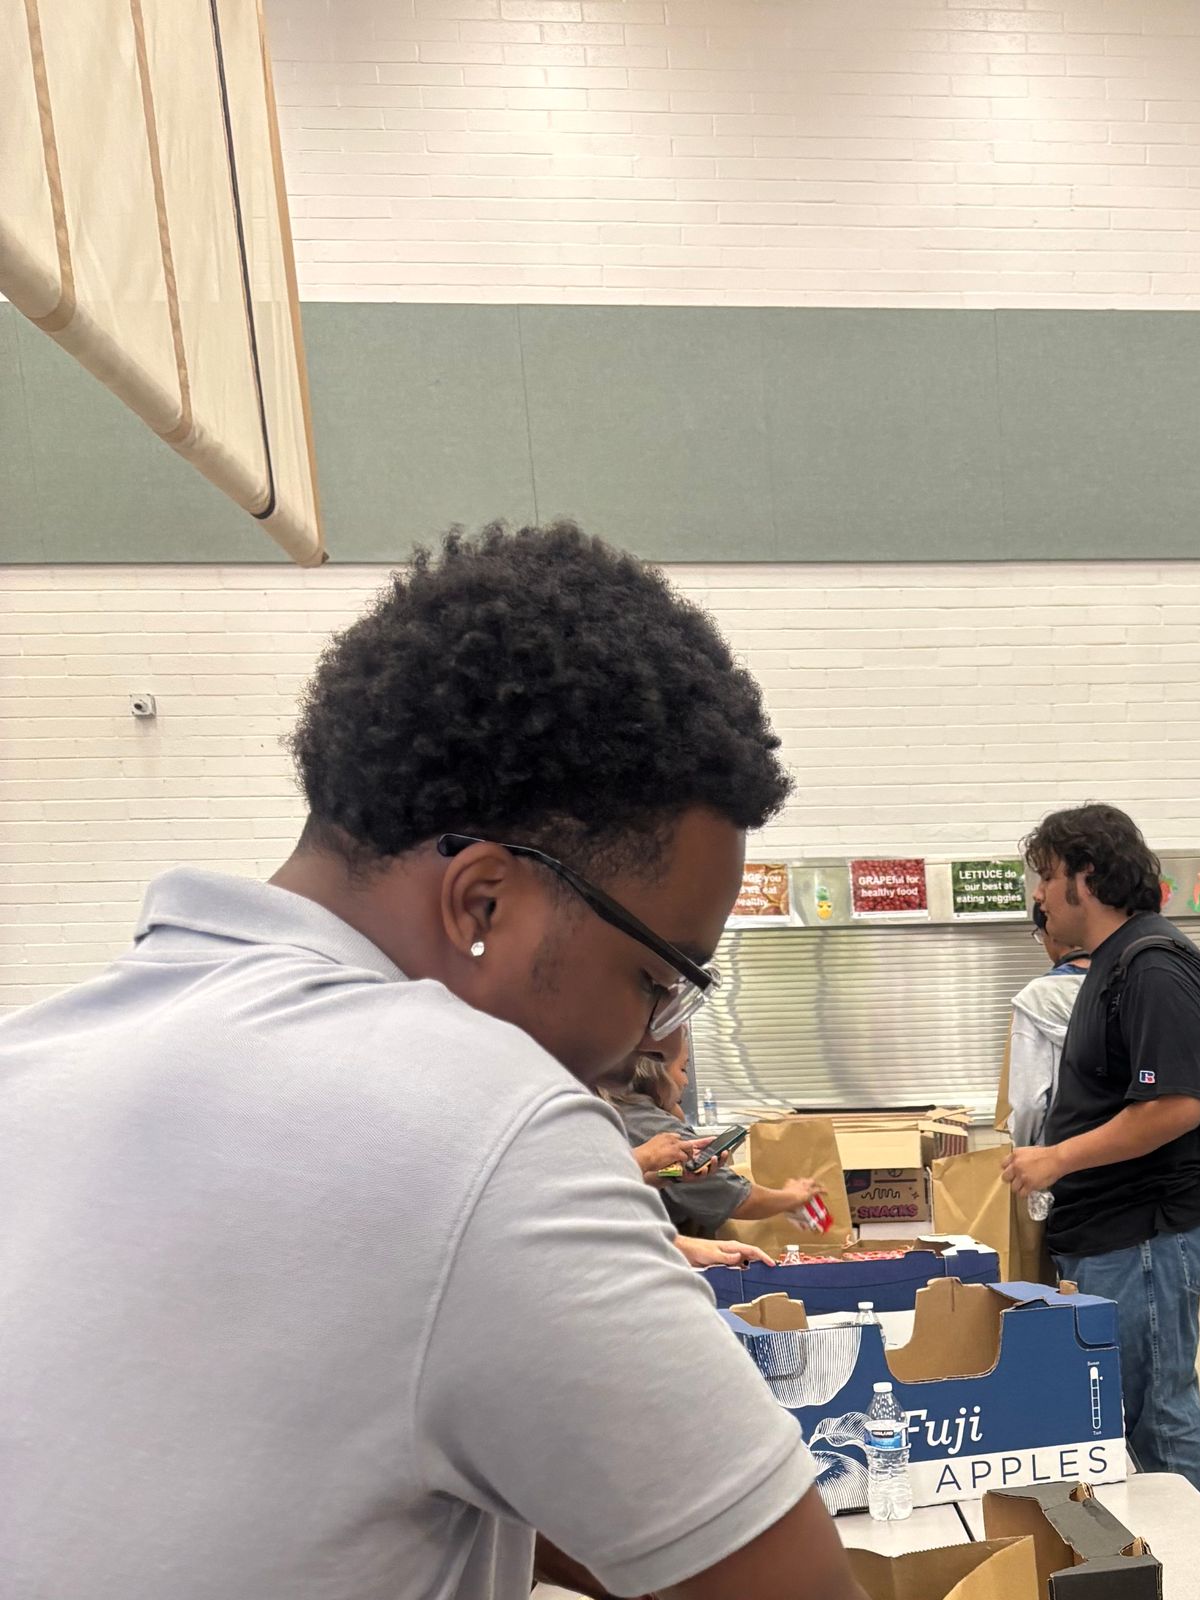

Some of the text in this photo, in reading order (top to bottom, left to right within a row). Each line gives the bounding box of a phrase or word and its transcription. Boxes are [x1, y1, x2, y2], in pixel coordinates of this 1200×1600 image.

[858, 874, 920, 885] GRAPEful for
[959, 869, 1017, 879] LETTUCE do
[763, 875, 782, 886] you
[762, 886, 777, 895] eat
[964, 882, 1013, 891] our best at
[861, 887, 918, 898] healthy food
[956, 894, 1021, 904] eating veggies
[857, 1203, 918, 1220] SNACKS
[901, 1405, 984, 1455] Fuji
[935, 1446, 1108, 1494] APPLES
